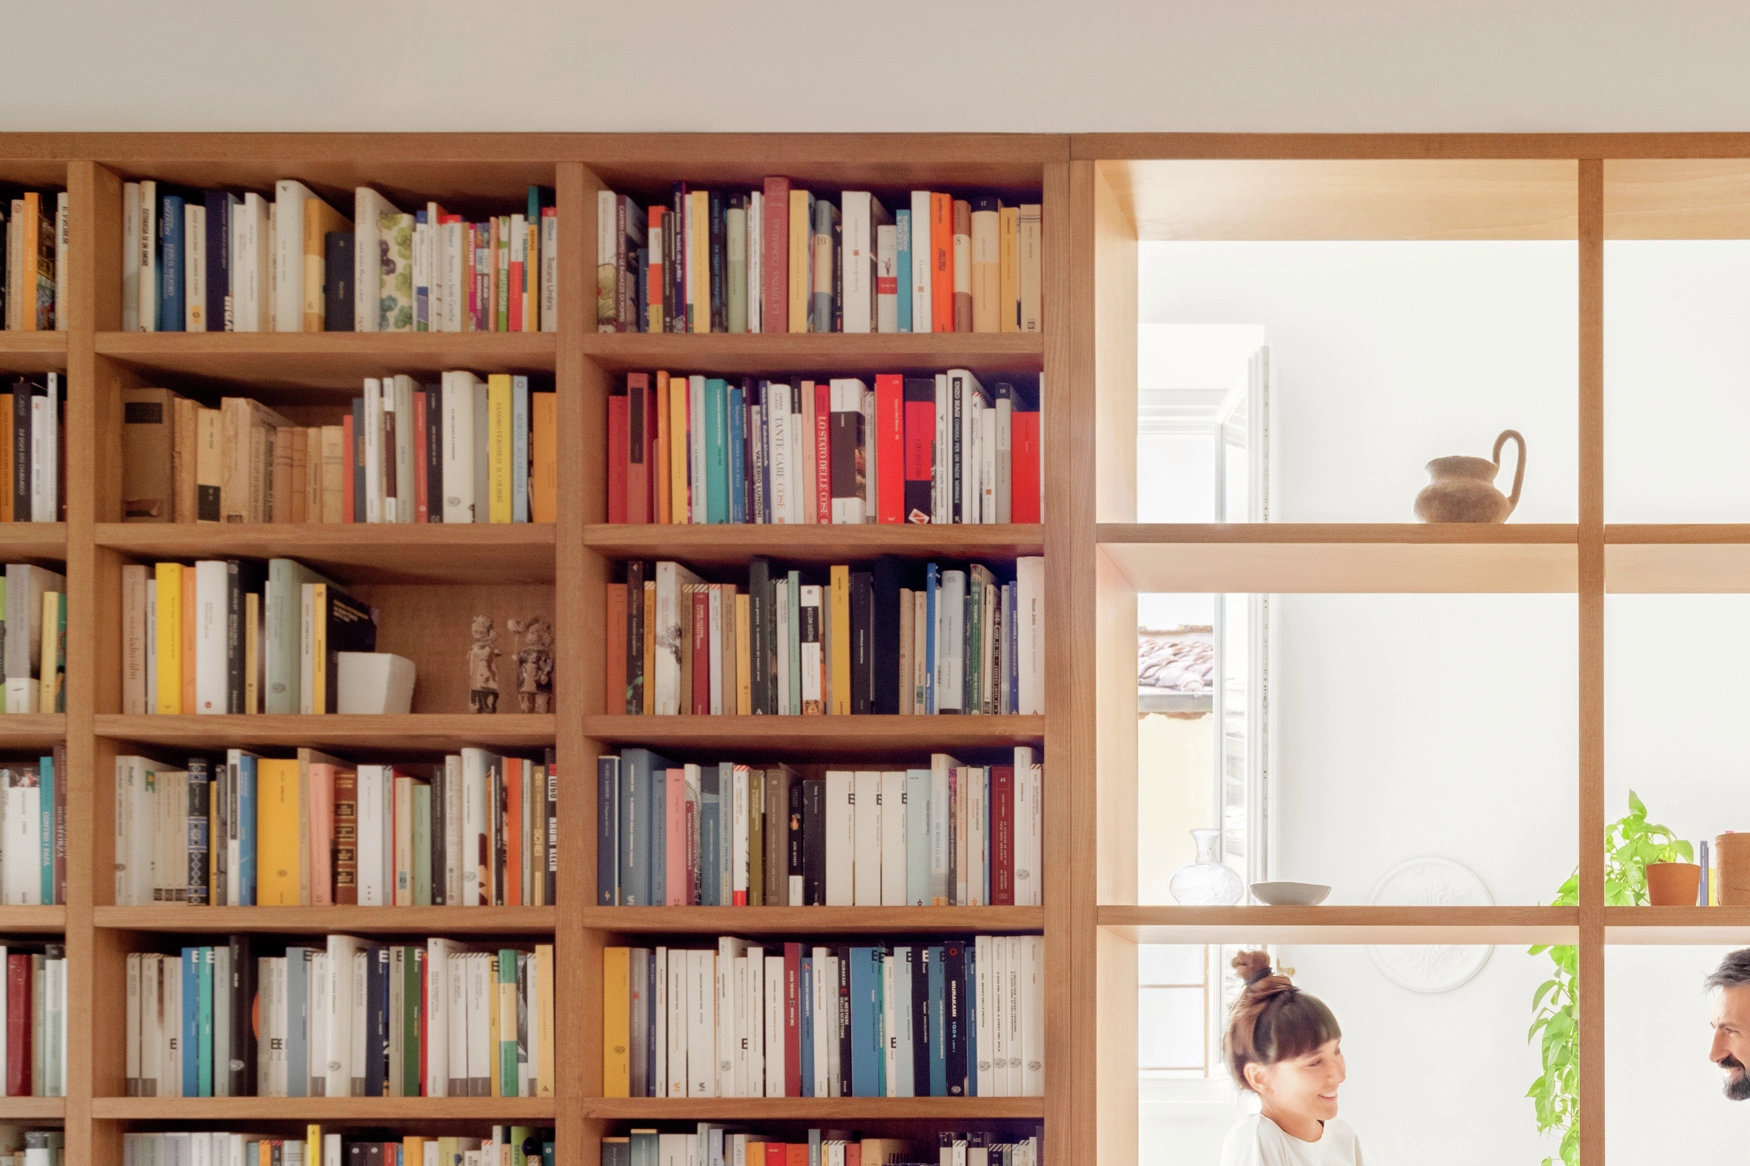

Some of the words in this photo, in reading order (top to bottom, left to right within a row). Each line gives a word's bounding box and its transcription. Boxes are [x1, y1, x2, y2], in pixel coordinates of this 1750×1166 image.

[771, 219, 779, 266] COMMEDIA
[500, 271, 508, 311] AMSTERDAM
[771, 272, 779, 299] DIVINA
[771, 304, 779, 314] LA
[775, 416, 783, 450] TANTE
[819, 416, 826, 429] LO
[819, 430, 827, 458] STATO
[775, 453, 784, 480] CARE
[819, 460, 827, 490] DELLE
[777, 483, 785, 509] COSE
[820, 492, 828, 516] COSE
[534, 829, 542, 856] SCHEI
[378, 950, 389, 962] E
[741, 1038, 748, 1049] E
[890, 1037, 897, 1049] E
